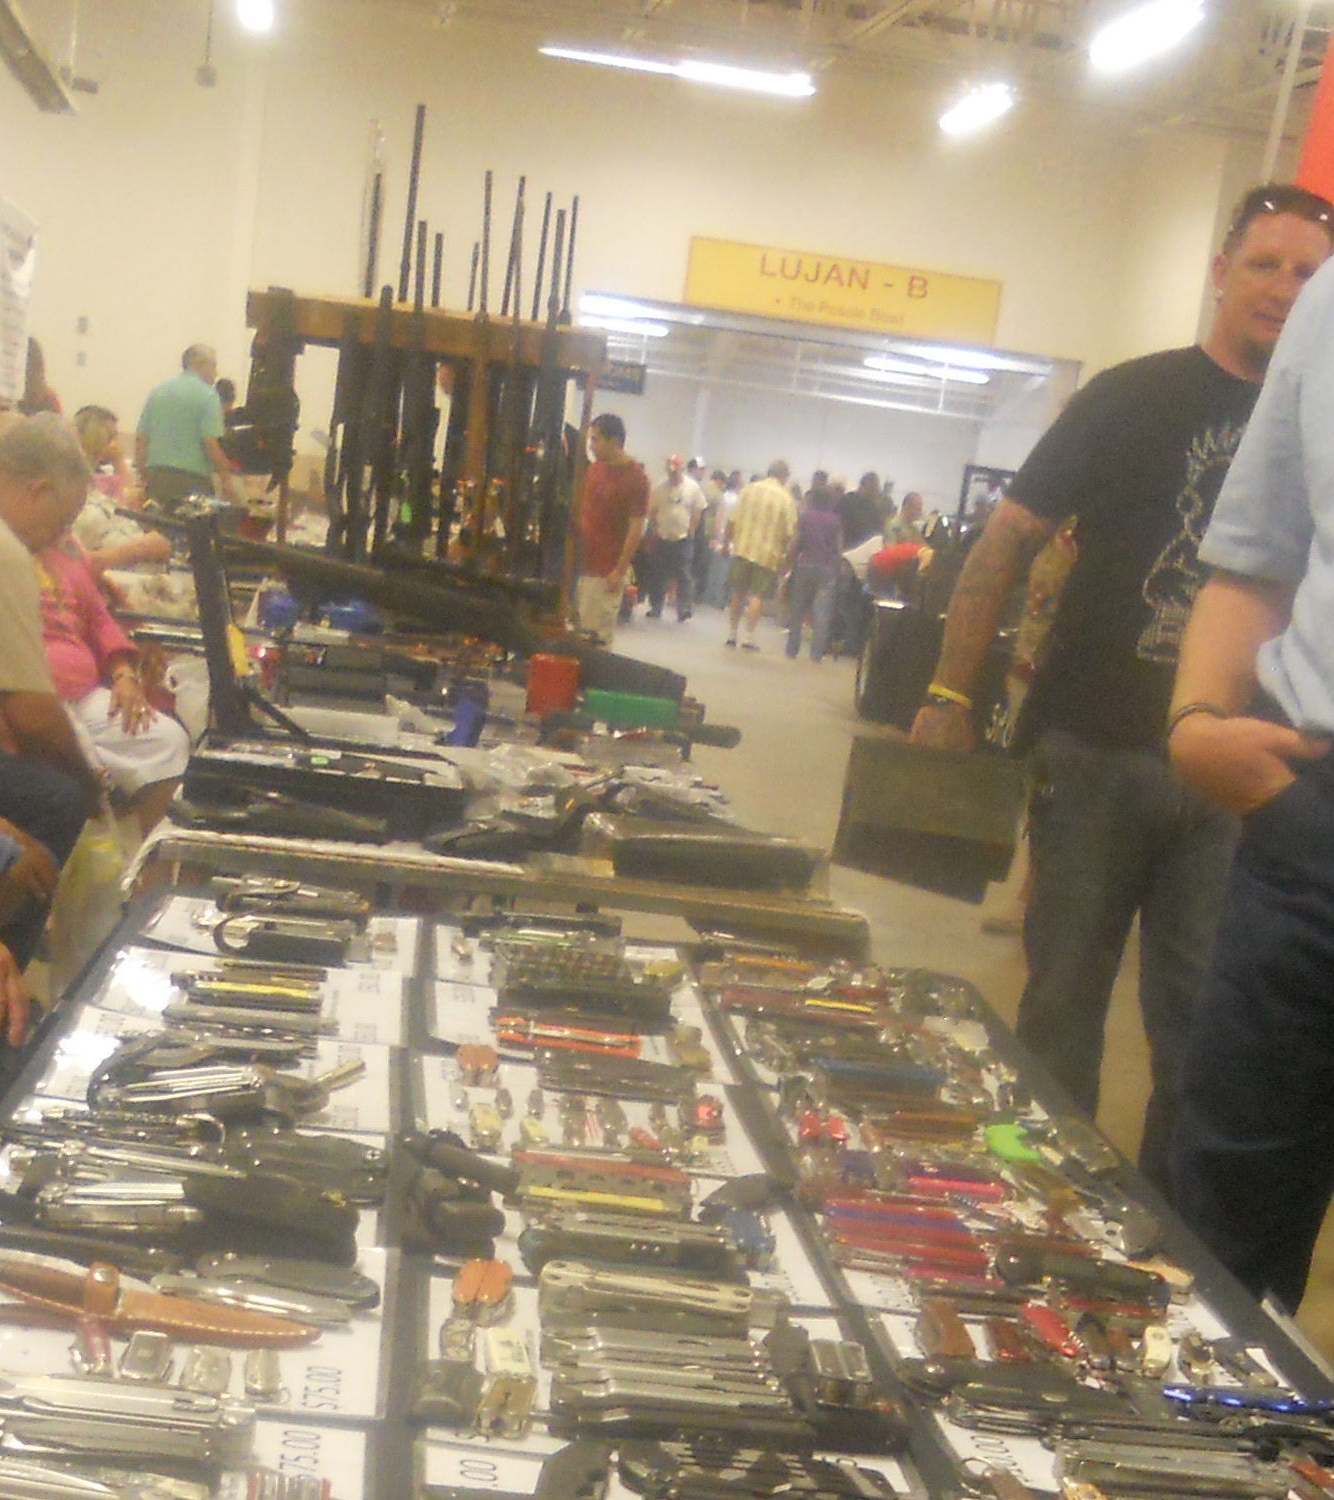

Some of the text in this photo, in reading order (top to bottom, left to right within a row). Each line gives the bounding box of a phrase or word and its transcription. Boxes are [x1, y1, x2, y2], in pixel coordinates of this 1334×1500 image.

[760, 253, 870, 290] LUJAN
[907, 275, 929, 300] B
[279, 1429, 321, 1480] 75.00
